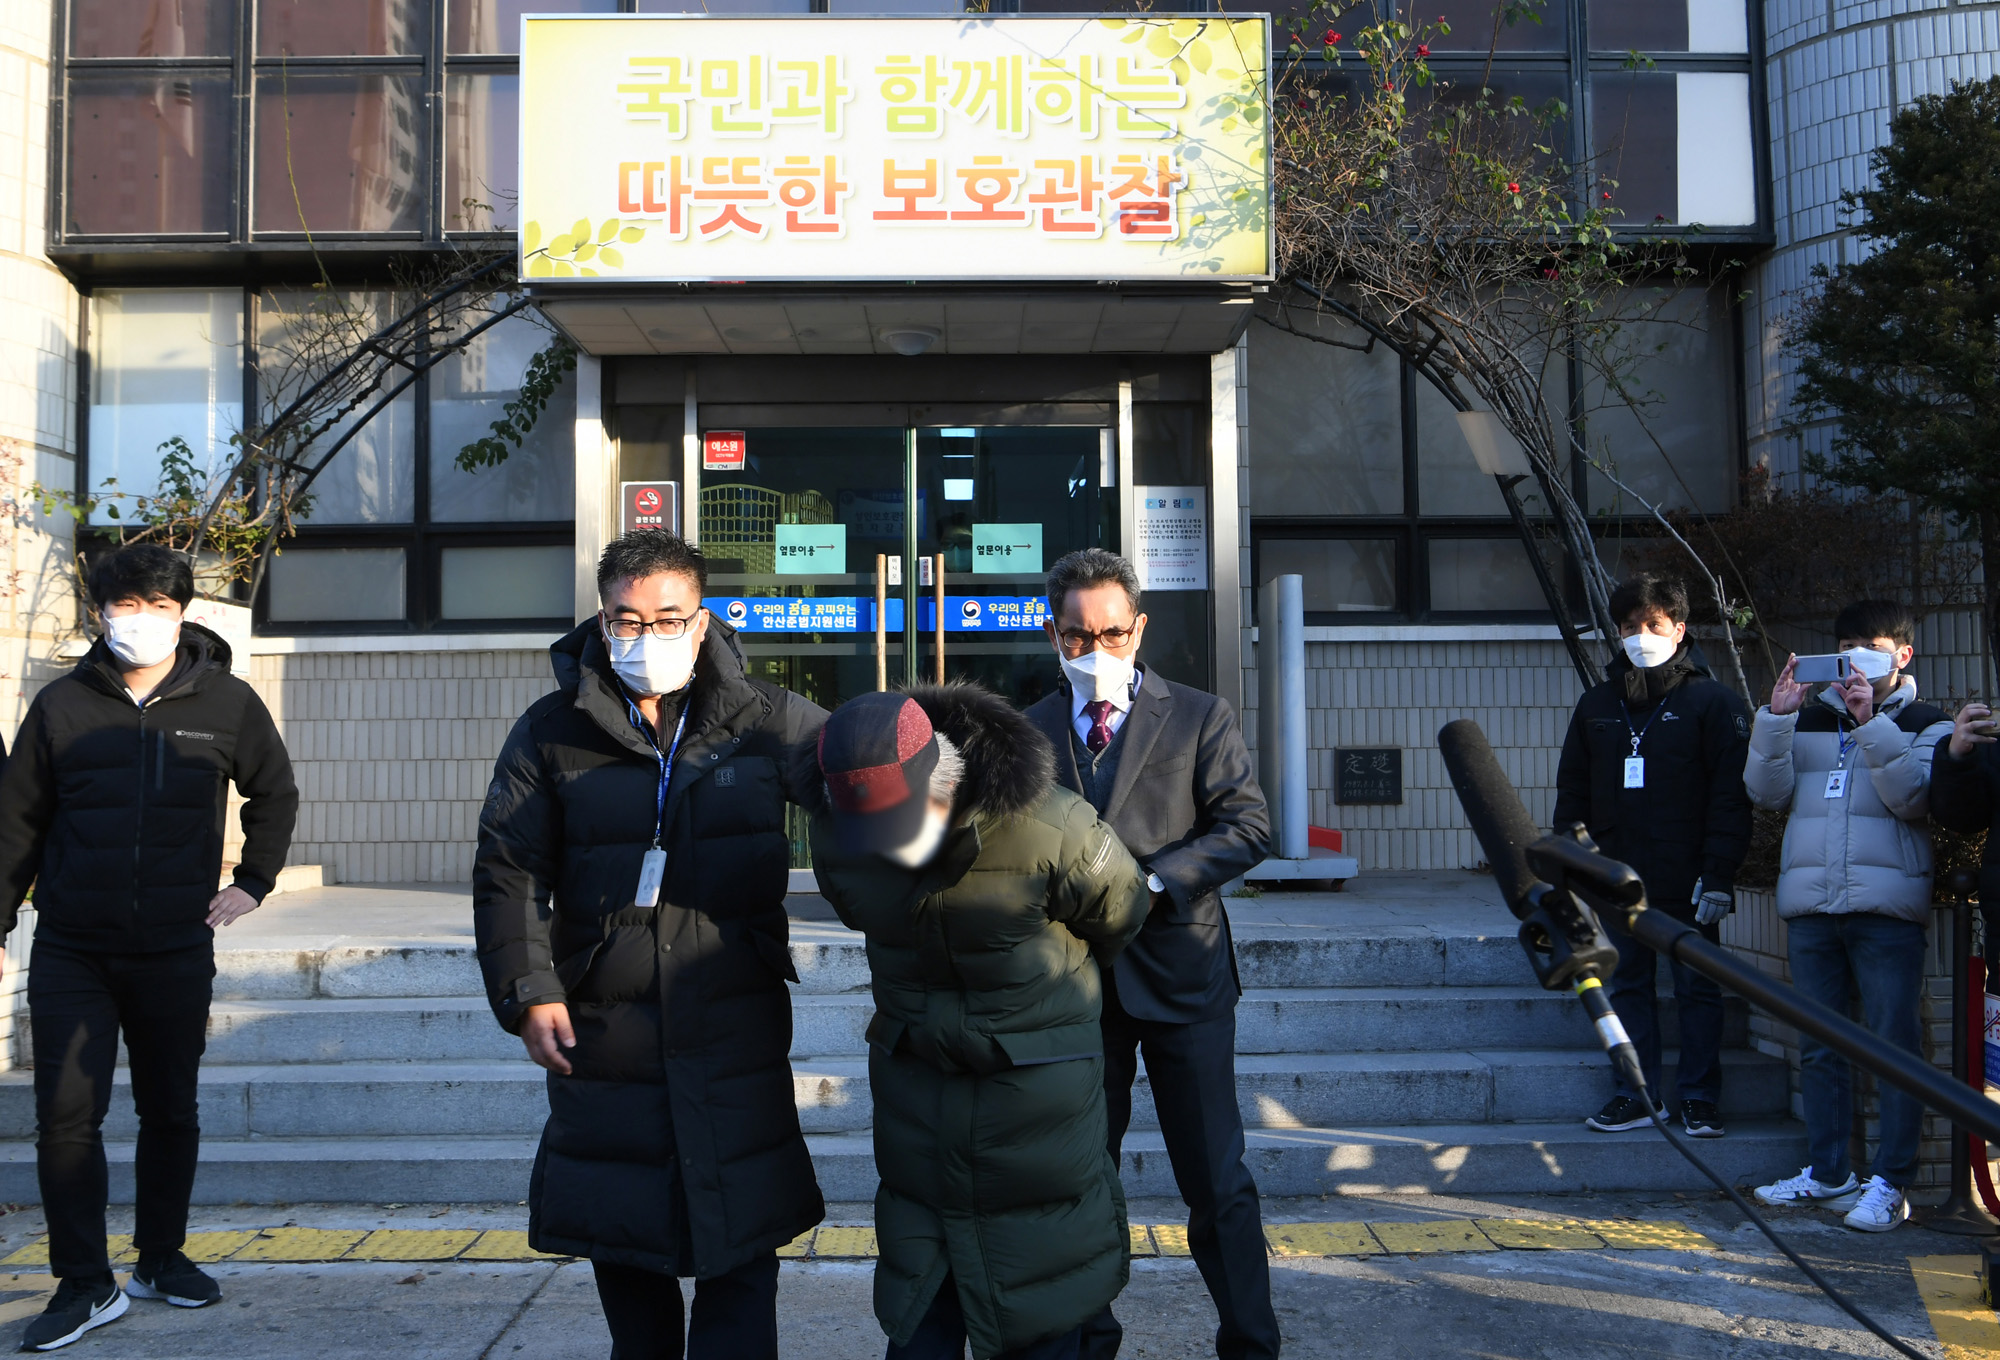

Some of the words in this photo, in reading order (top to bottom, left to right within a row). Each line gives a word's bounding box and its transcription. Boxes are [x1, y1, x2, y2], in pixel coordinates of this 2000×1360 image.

[616, 55, 848, 133] 국민과
[874, 55, 1179, 133] 함께하는
[618, 155, 848, 234] 따뜻한
[873, 154, 1181, 234] 보호관찰
[711, 440, 738, 452] 에스원
[779, 545, 816, 557] 옆문이용
[976, 544, 1012, 556] 옆문이용
[753, 604, 785, 616] 우리의
[789, 602, 811, 616] 꿈을
[815, 604, 857, 616] 꽃피우는
[988, 603, 1020, 614] 우리의
[1023, 601, 1046, 614] 꿈을
[762, 616, 857, 628] 안산준법지원센터
